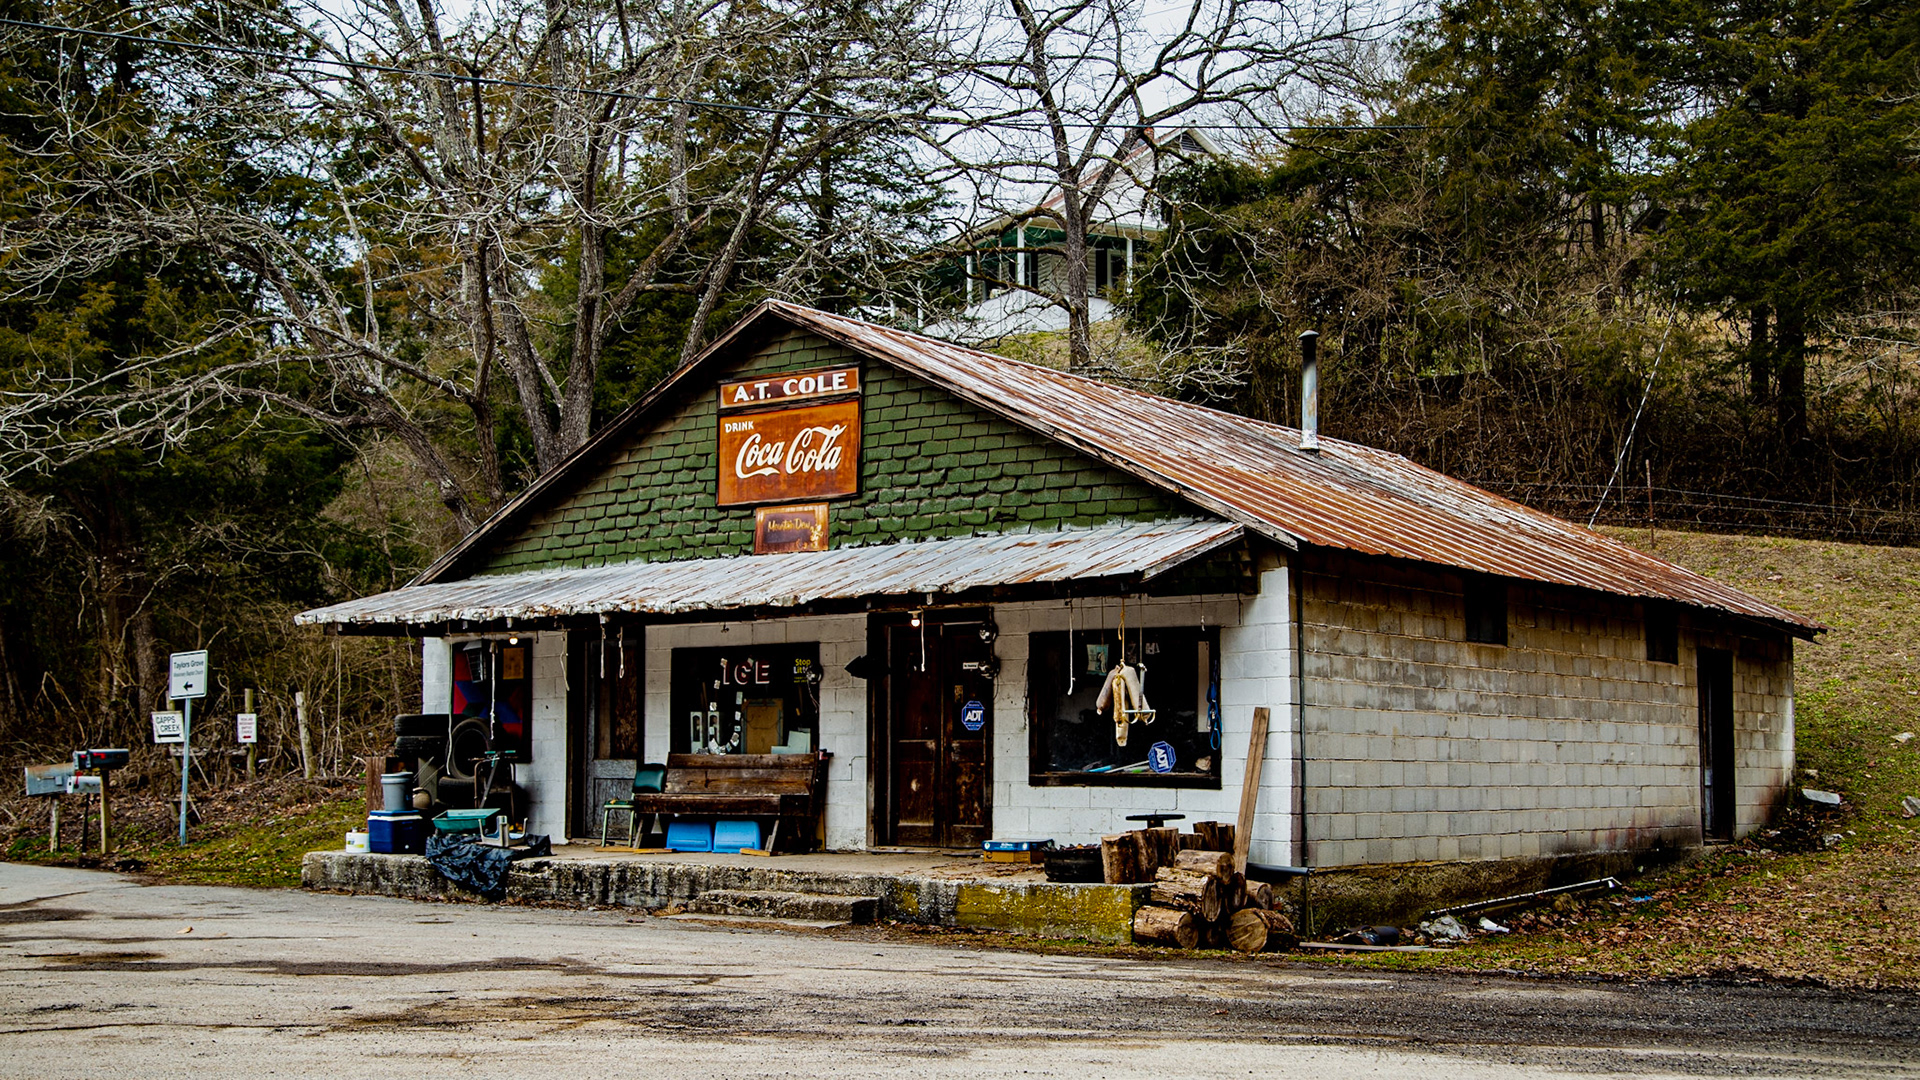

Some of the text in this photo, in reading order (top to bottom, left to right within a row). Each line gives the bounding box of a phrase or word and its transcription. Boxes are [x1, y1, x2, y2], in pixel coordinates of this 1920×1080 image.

[733, 372, 848, 403] A.T. COLE
[725, 420, 755, 433] DRINK
[795, 658, 811, 667] Stop
[722, 661, 771, 685] ICE
[155, 716, 176, 724] CAPPS
[964, 710, 983, 722] ADT
[160, 724, 180, 732] CREEK
[1154, 747, 1169, 768] ADT
